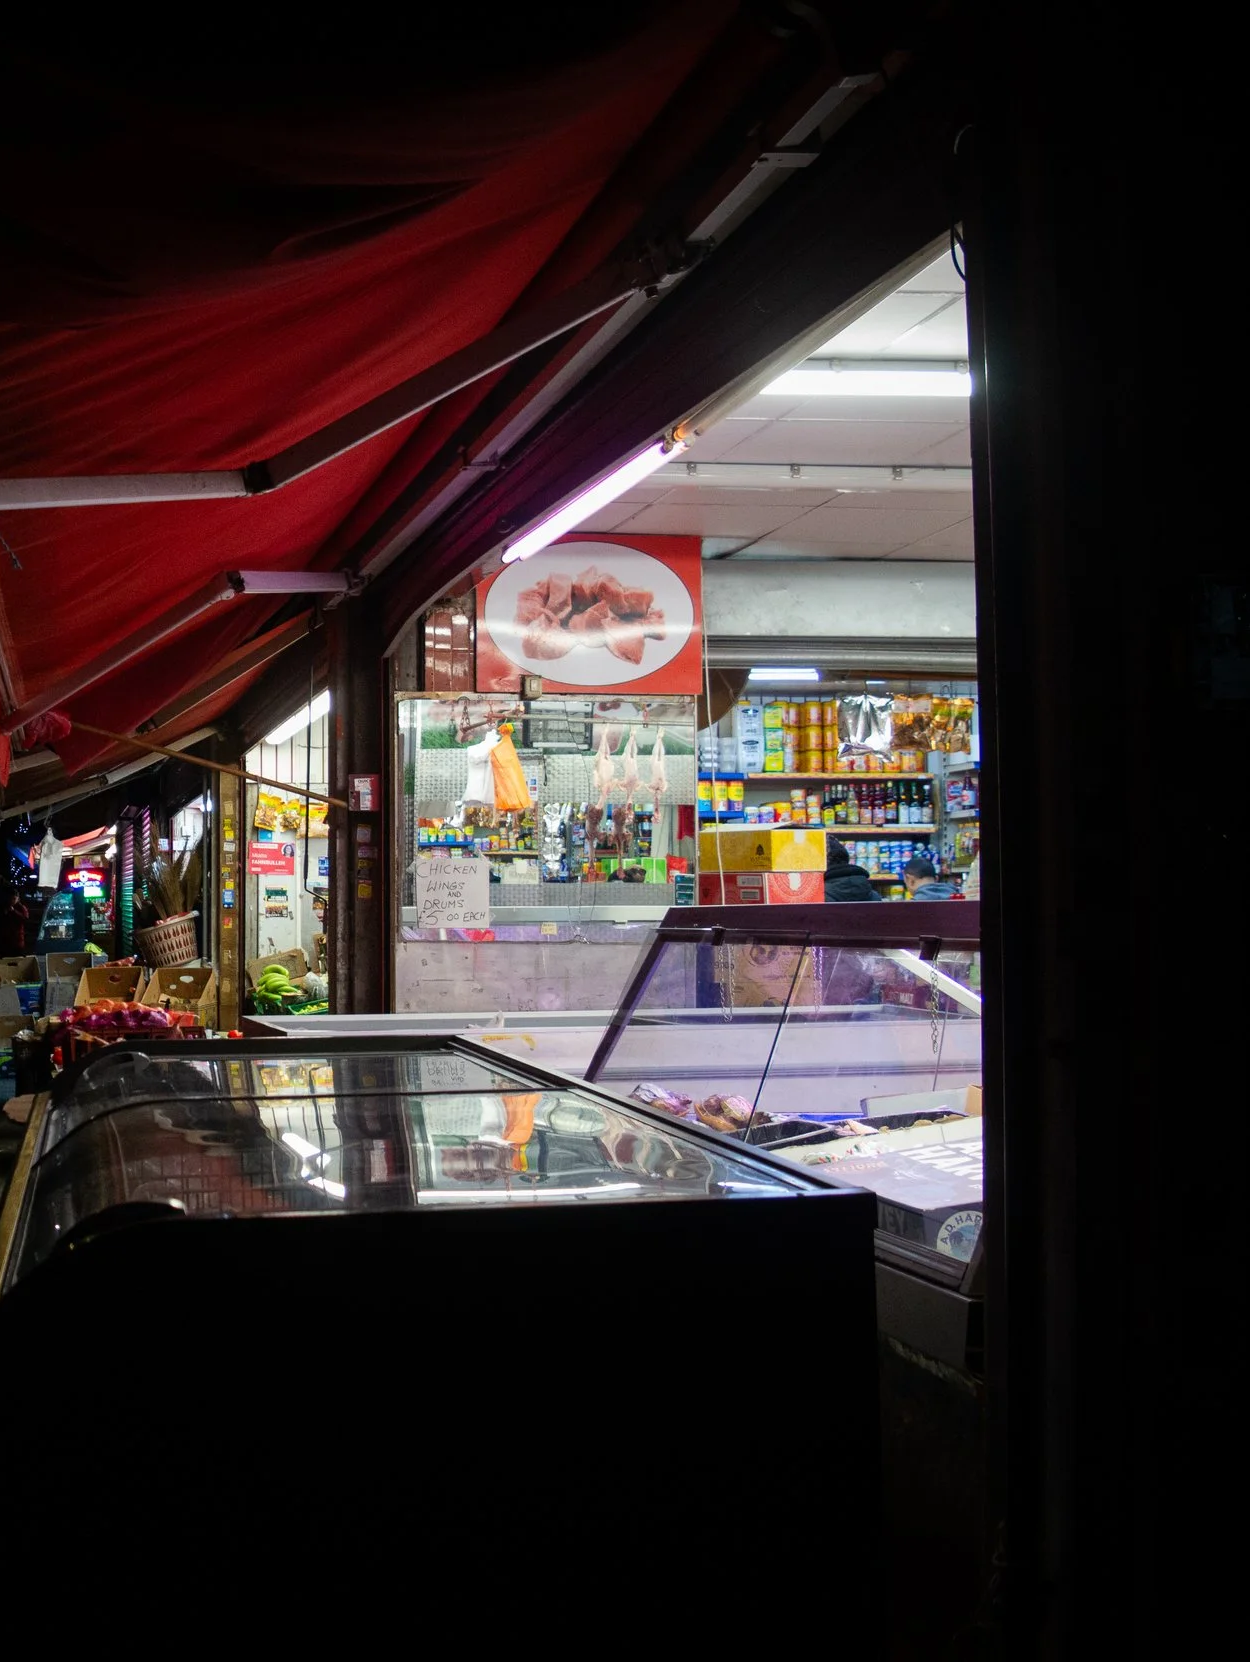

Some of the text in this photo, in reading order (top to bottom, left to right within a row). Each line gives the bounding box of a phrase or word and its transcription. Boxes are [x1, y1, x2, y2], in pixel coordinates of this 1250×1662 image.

[416, 862, 477, 878] CHICKEN
[426, 881, 465, 892] WINGS
[423, 899, 464, 910] DRUMS
[463, 912, 486, 922] EACH
